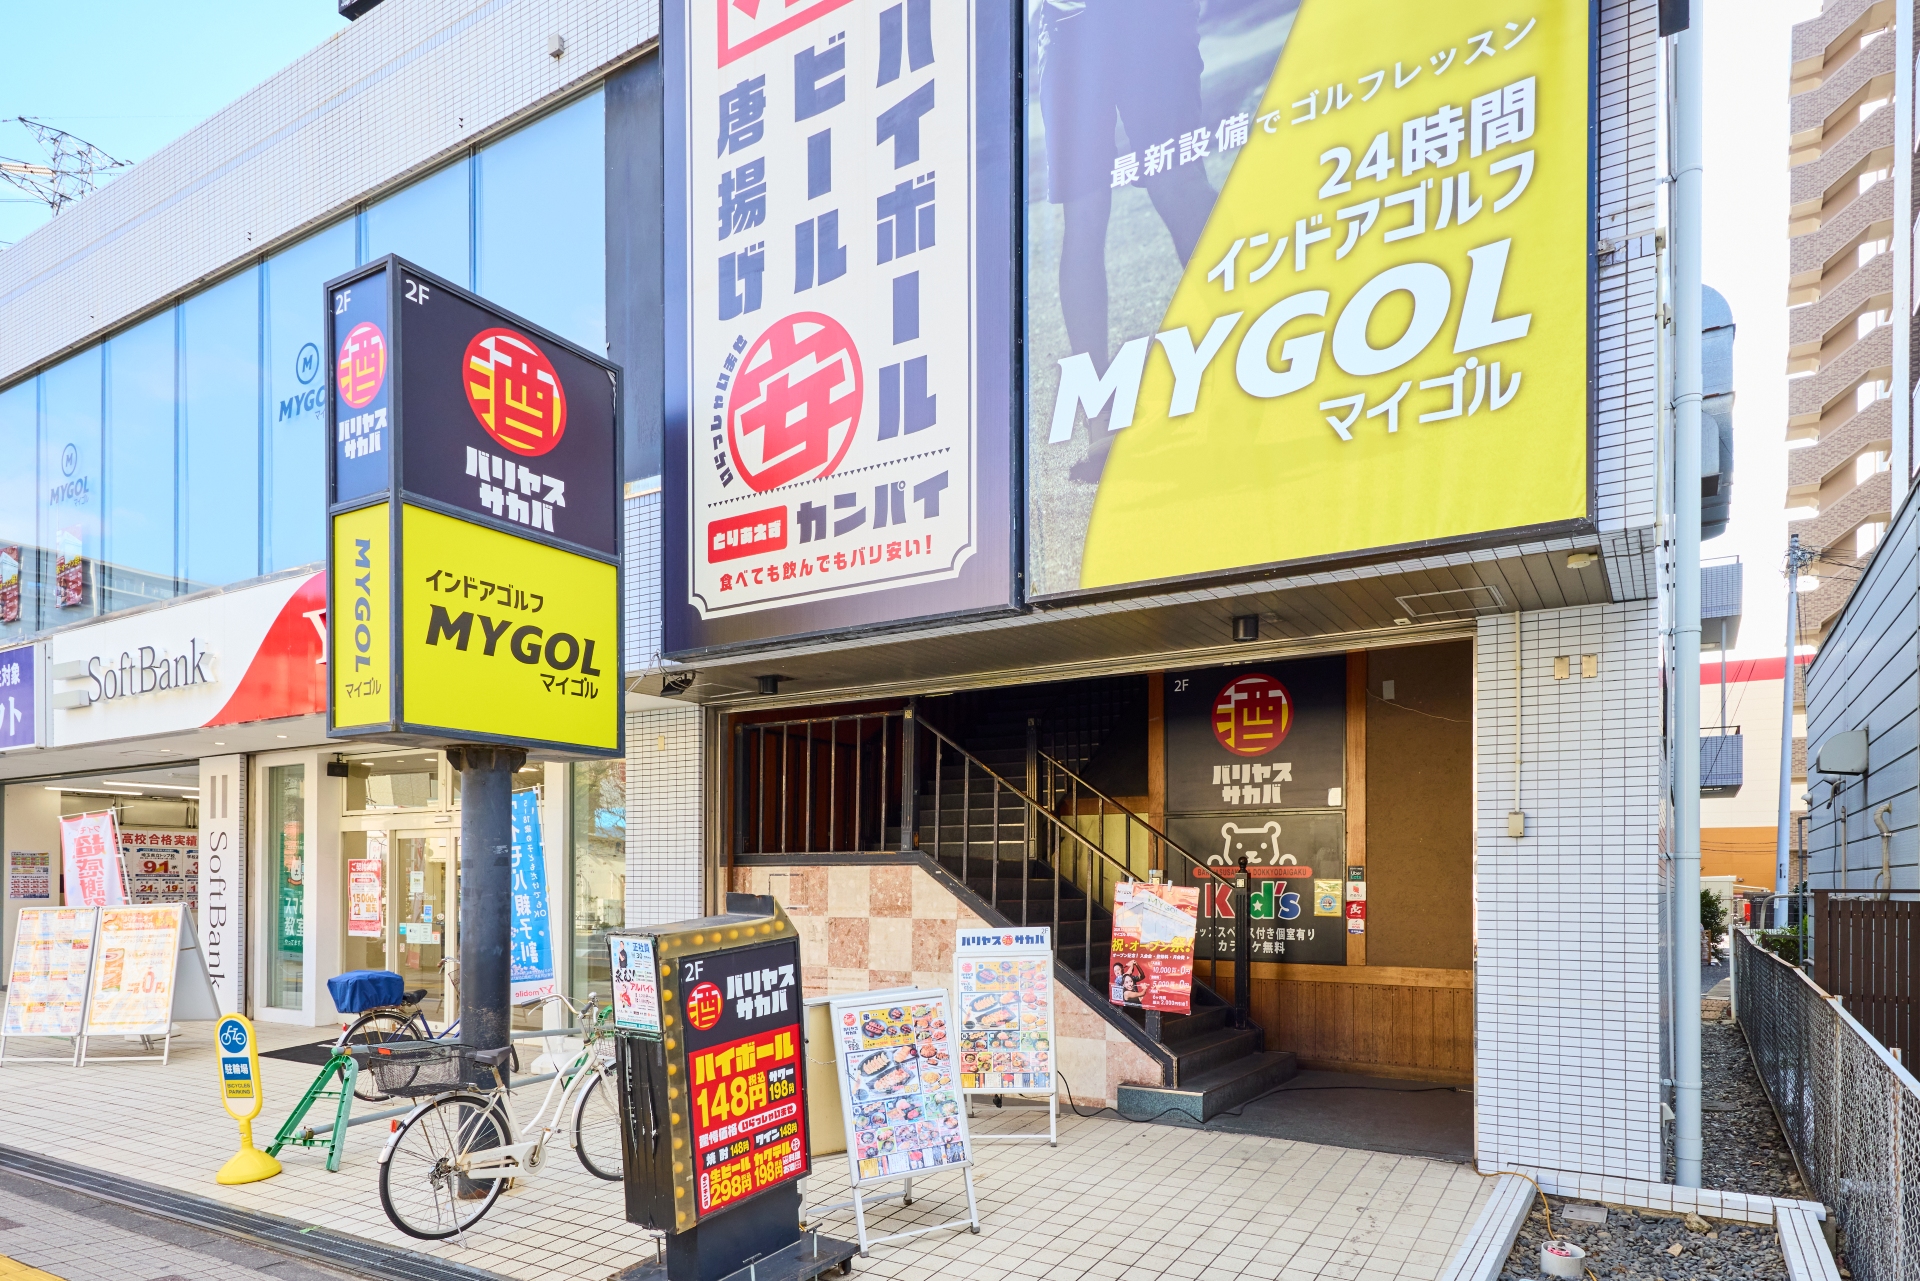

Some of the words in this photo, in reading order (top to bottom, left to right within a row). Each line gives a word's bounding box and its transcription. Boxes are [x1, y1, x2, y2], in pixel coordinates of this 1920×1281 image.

[1318, 76, 1537, 199] 24時間
[794, 30, 847, 295] ビール
[717, 73, 767, 321] 唐揚げ
[876, 0, 936, 442] ハイボール
[1207, 150, 1536, 292] インドアゴルフ
[335, 289, 352, 316] 2F
[404, 279, 431, 306] 2F
[1047, 237, 1532, 443] MYGOL
[278, 385, 325, 422] MYGO
[1319, 356, 1522, 442] マイゴル
[338, 407, 388, 443] バリヤス
[344, 431, 382, 460] サカバ
[50, 475, 89, 506] MYGOL
[465, 445, 566, 508] バリヤス
[479, 485, 556, 534] サカバ
[797, 469, 949, 544] カンパイ
[713, 520, 782, 551] とりあえず
[354, 538, 371, 673] MYGOL
[424, 568, 545, 613] インドアゴルフ
[302, 607, 327, 665] Y
[424, 603, 601, 678] MYGOL
[0, 662, 21, 688] 対象
[87, 636, 208, 704] SoftBank
[345, 676, 382, 699] マイゴル
[539, 672, 600, 702] マイゴル
[1173, 678, 1190, 693] 2F
[1212, 762, 1293, 785] バリヤス
[1222, 783, 1282, 805] サカバ
[143, 860, 170, 874] 91
[208, 831, 228, 990] SoftBank
[1204, 880, 1301, 921] Kd's
[684, 960, 704, 983] 2F
[726, 963, 796, 1001] バリヤス
[736, 988, 789, 1021] サカバ
[224, 1063, 249, 1075] 駐輪場
[694, 1031, 795, 1086] ハイボール
[696, 1075, 768, 1128] 148円
[768, 1079, 795, 1101] 198円
[779, 1122, 798, 1138] 148円
[729, 1139, 750, 1157] 148円
[753, 1140, 792, 1168] カクテル
[709, 1155, 752, 1186] 生ビール
[754, 1160, 784, 1188] 198円
[710, 1173, 752, 1207] 298円
